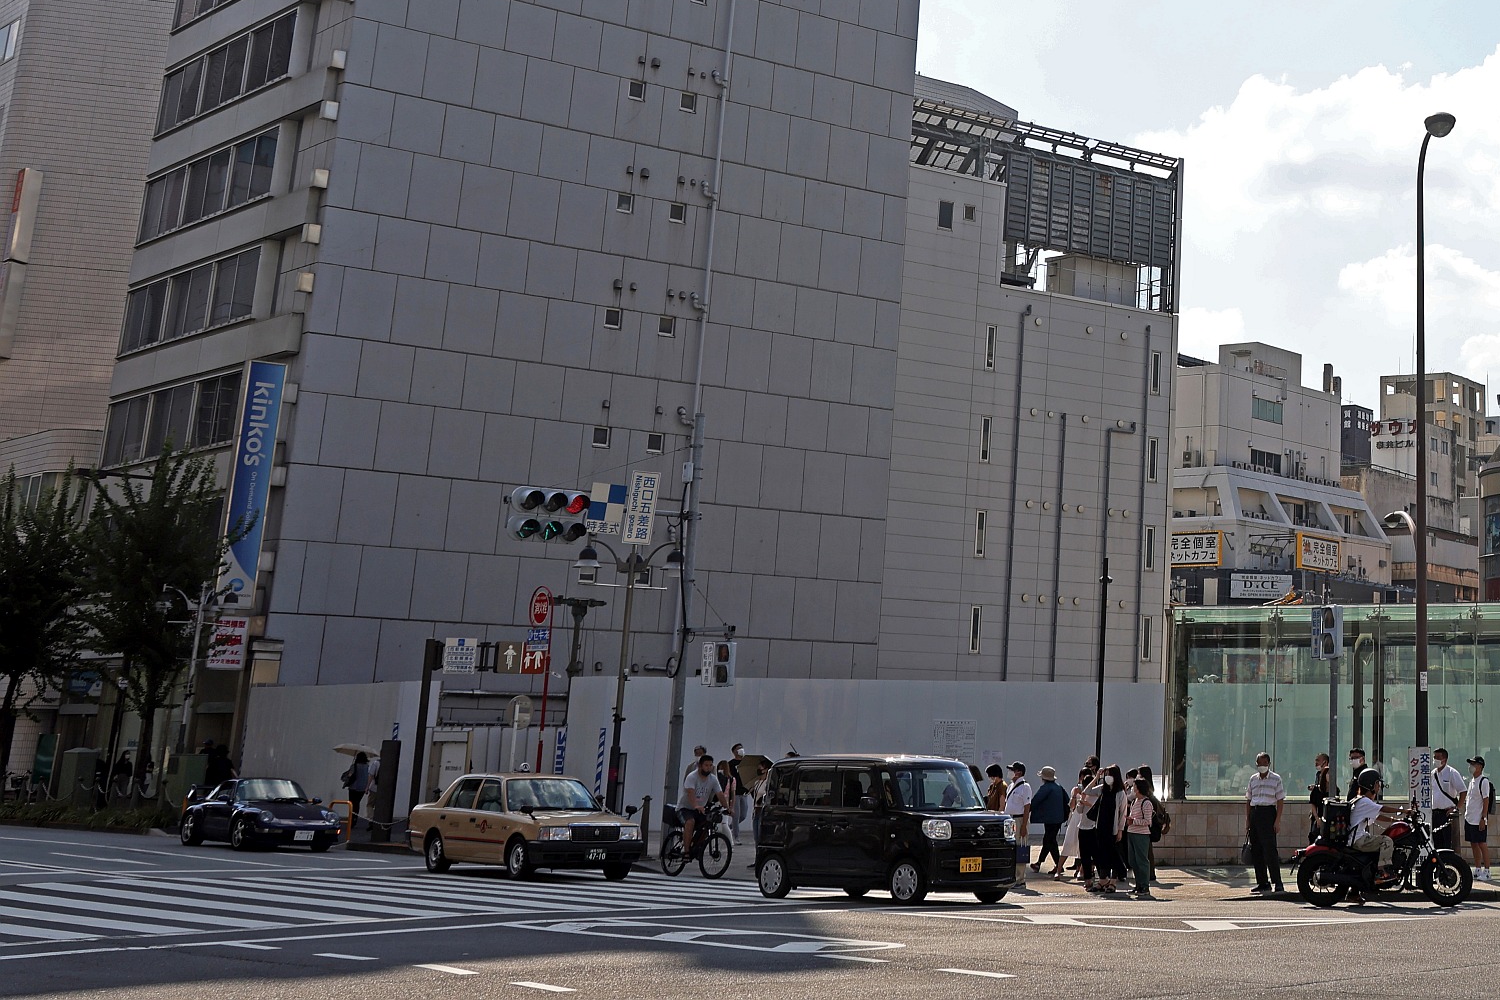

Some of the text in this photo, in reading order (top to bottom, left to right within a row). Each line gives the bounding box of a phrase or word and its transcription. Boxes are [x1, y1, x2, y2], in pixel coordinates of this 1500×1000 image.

[586, 521, 620, 535] 時差式
[635, 476, 657, 540] 西口五差路
[1420, 753, 1431, 809] 交差点付近
